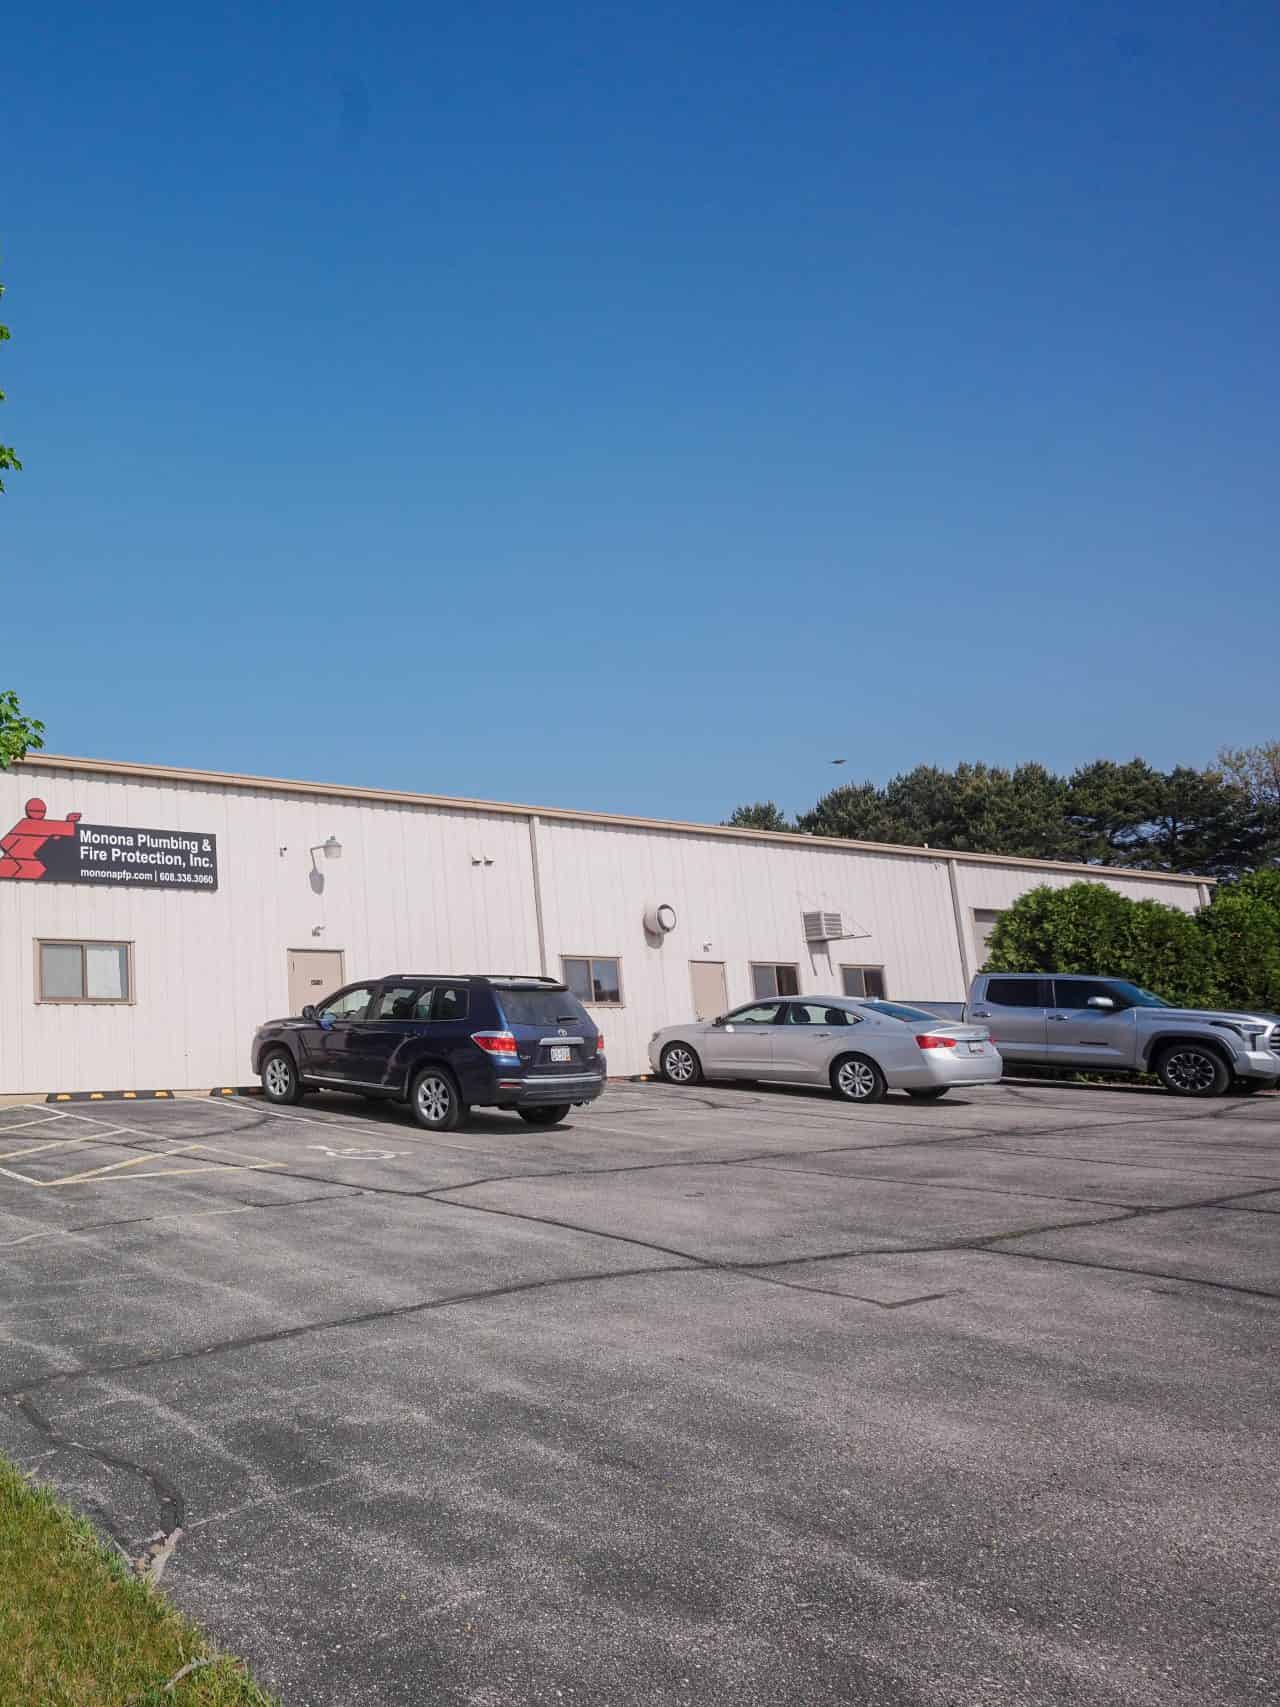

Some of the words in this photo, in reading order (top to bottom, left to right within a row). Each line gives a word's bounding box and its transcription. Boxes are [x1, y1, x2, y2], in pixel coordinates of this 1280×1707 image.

[79, 829, 134, 847] Monona
[137, 833, 199, 853] Plumbing
[201, 838, 212, 852] &
[79, 846, 108, 861] Fire
[111, 848, 187, 868] Protection,
[189, 853, 214, 868] Inc.
[79, 868, 153, 881] mononapfp.com
